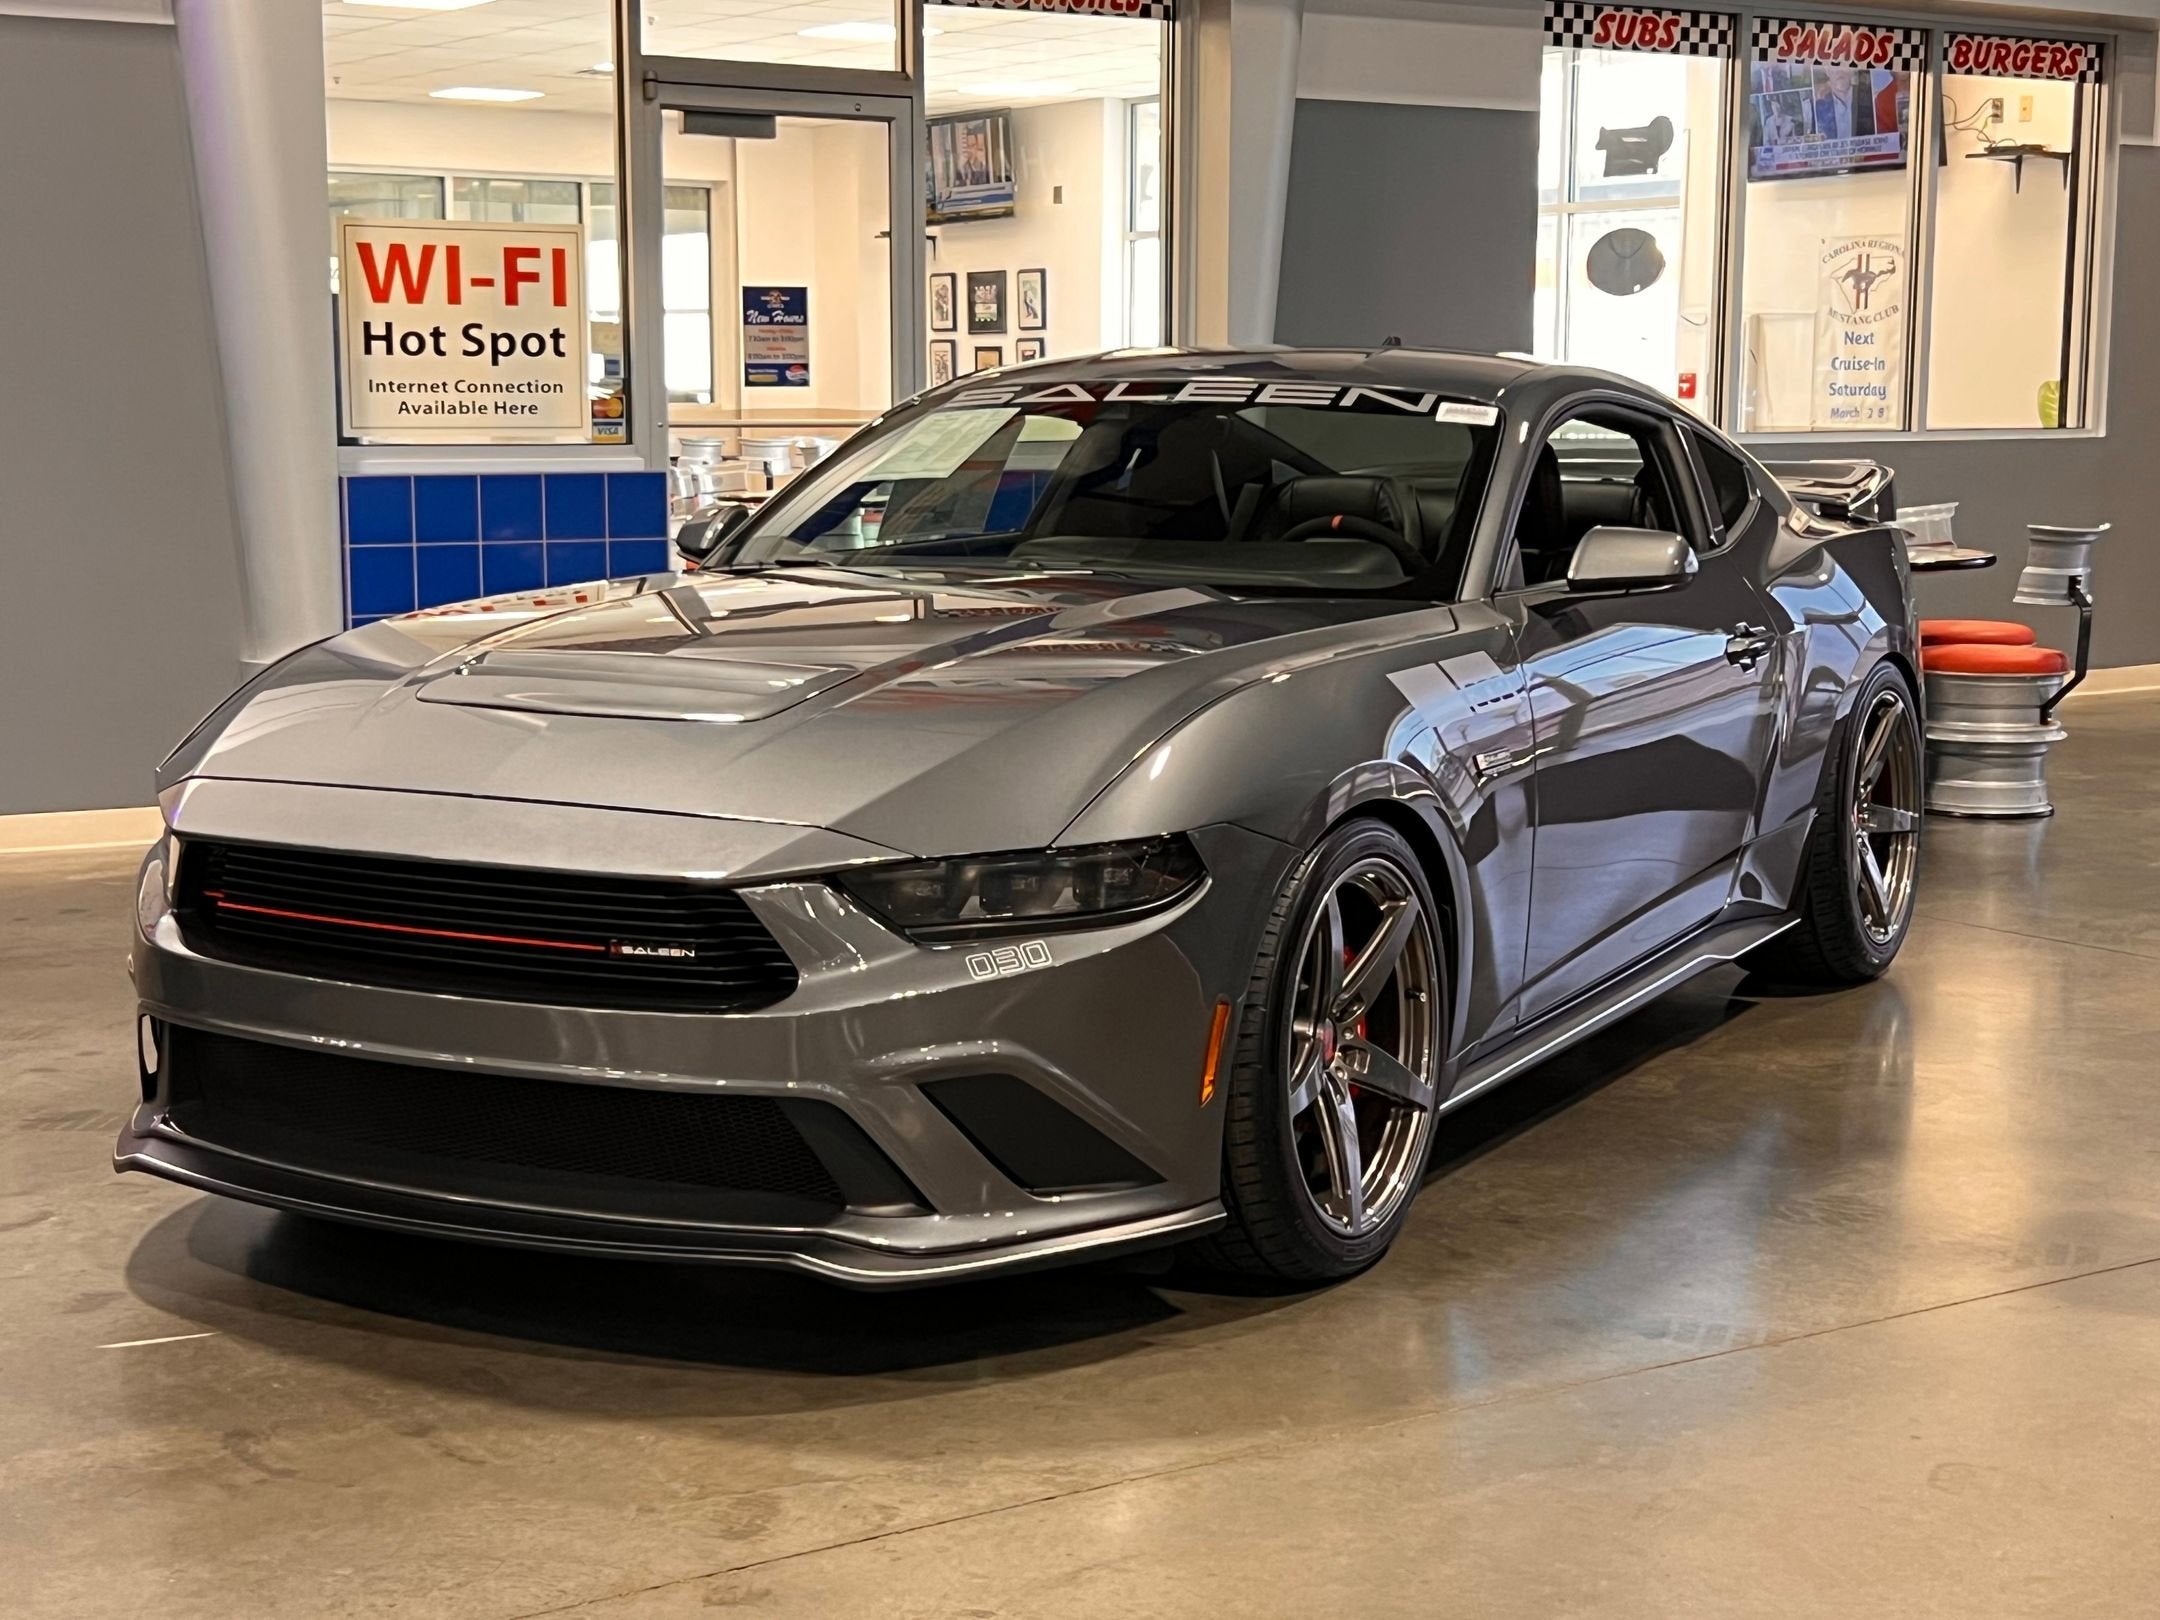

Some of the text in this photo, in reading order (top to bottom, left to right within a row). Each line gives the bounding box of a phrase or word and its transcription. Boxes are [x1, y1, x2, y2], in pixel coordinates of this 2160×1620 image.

[1594, 13, 1680, 49] SUBS
[1778, 27, 1894, 64] SALADS
[1953, 39, 2083, 77] BURGERS
[356, 242, 567, 307] WI-FI
[1873, 304, 1899, 322] CLUB
[363, 321, 566, 366] Hot Spot
[1844, 331, 1875, 345] Next
[1831, 356, 1886, 371] Cruise-In
[369, 379, 564, 394] Internet Connection
[1829, 382, 1887, 400] Saturday
[942, 382, 1438, 414] SALEEN
[398, 401, 539, 415] Available Here
[1830, 407, 1860, 419] March
[597, 427, 620, 435] VISA
[621, 946, 695, 957] SALEEN
[965, 940, 1053, 980] 030
